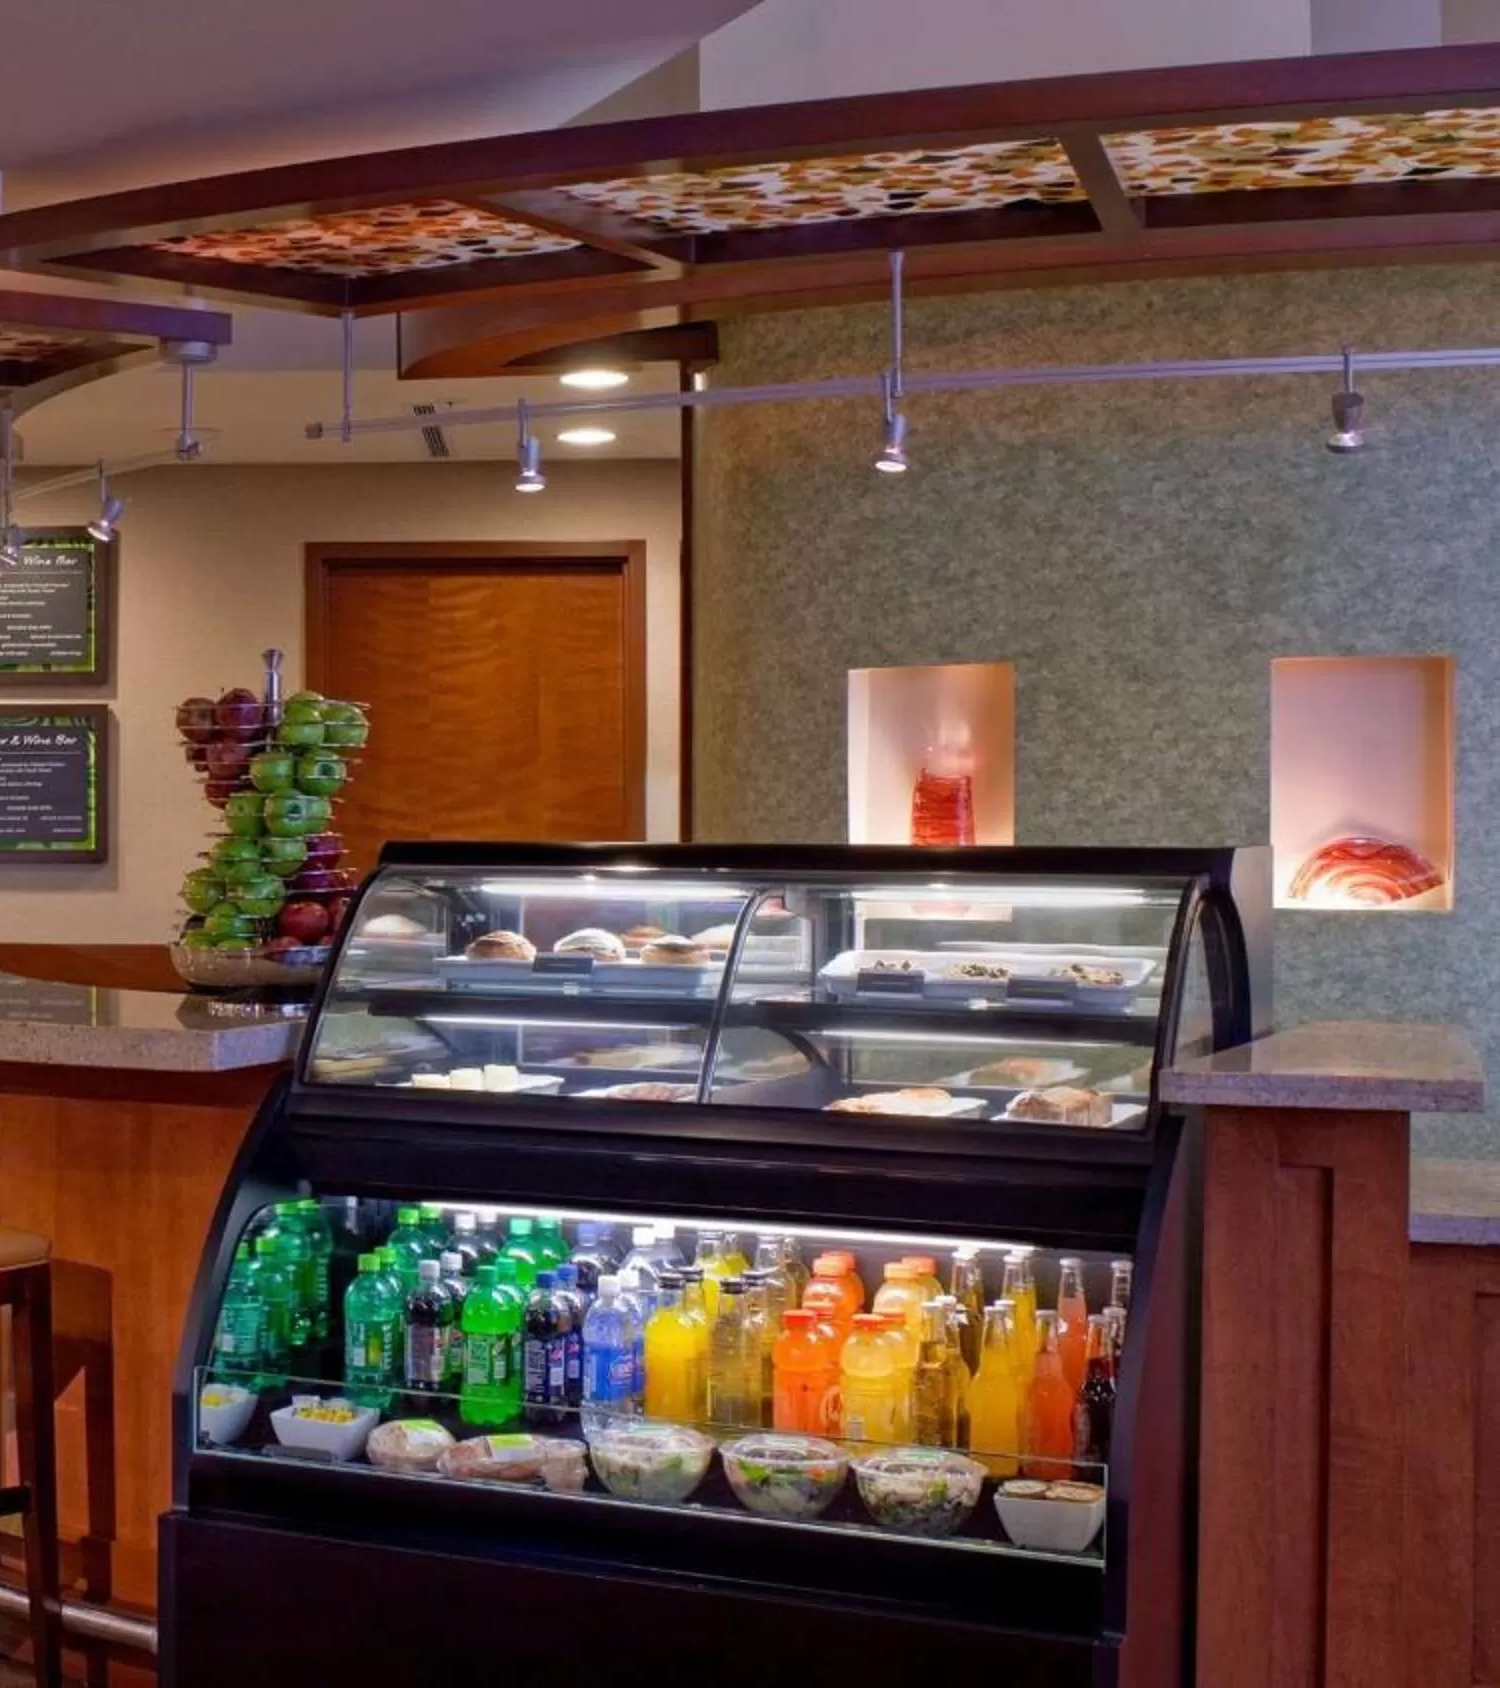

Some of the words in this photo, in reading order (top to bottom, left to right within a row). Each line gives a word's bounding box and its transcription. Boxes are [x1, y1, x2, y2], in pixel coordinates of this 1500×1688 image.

[23, 554, 52, 566] Wine
[55, 554, 79, 566] Bar
[9, 735, 21, 746] &
[23, 733, 52, 746] Wine
[55, 733, 79, 746] Bar
